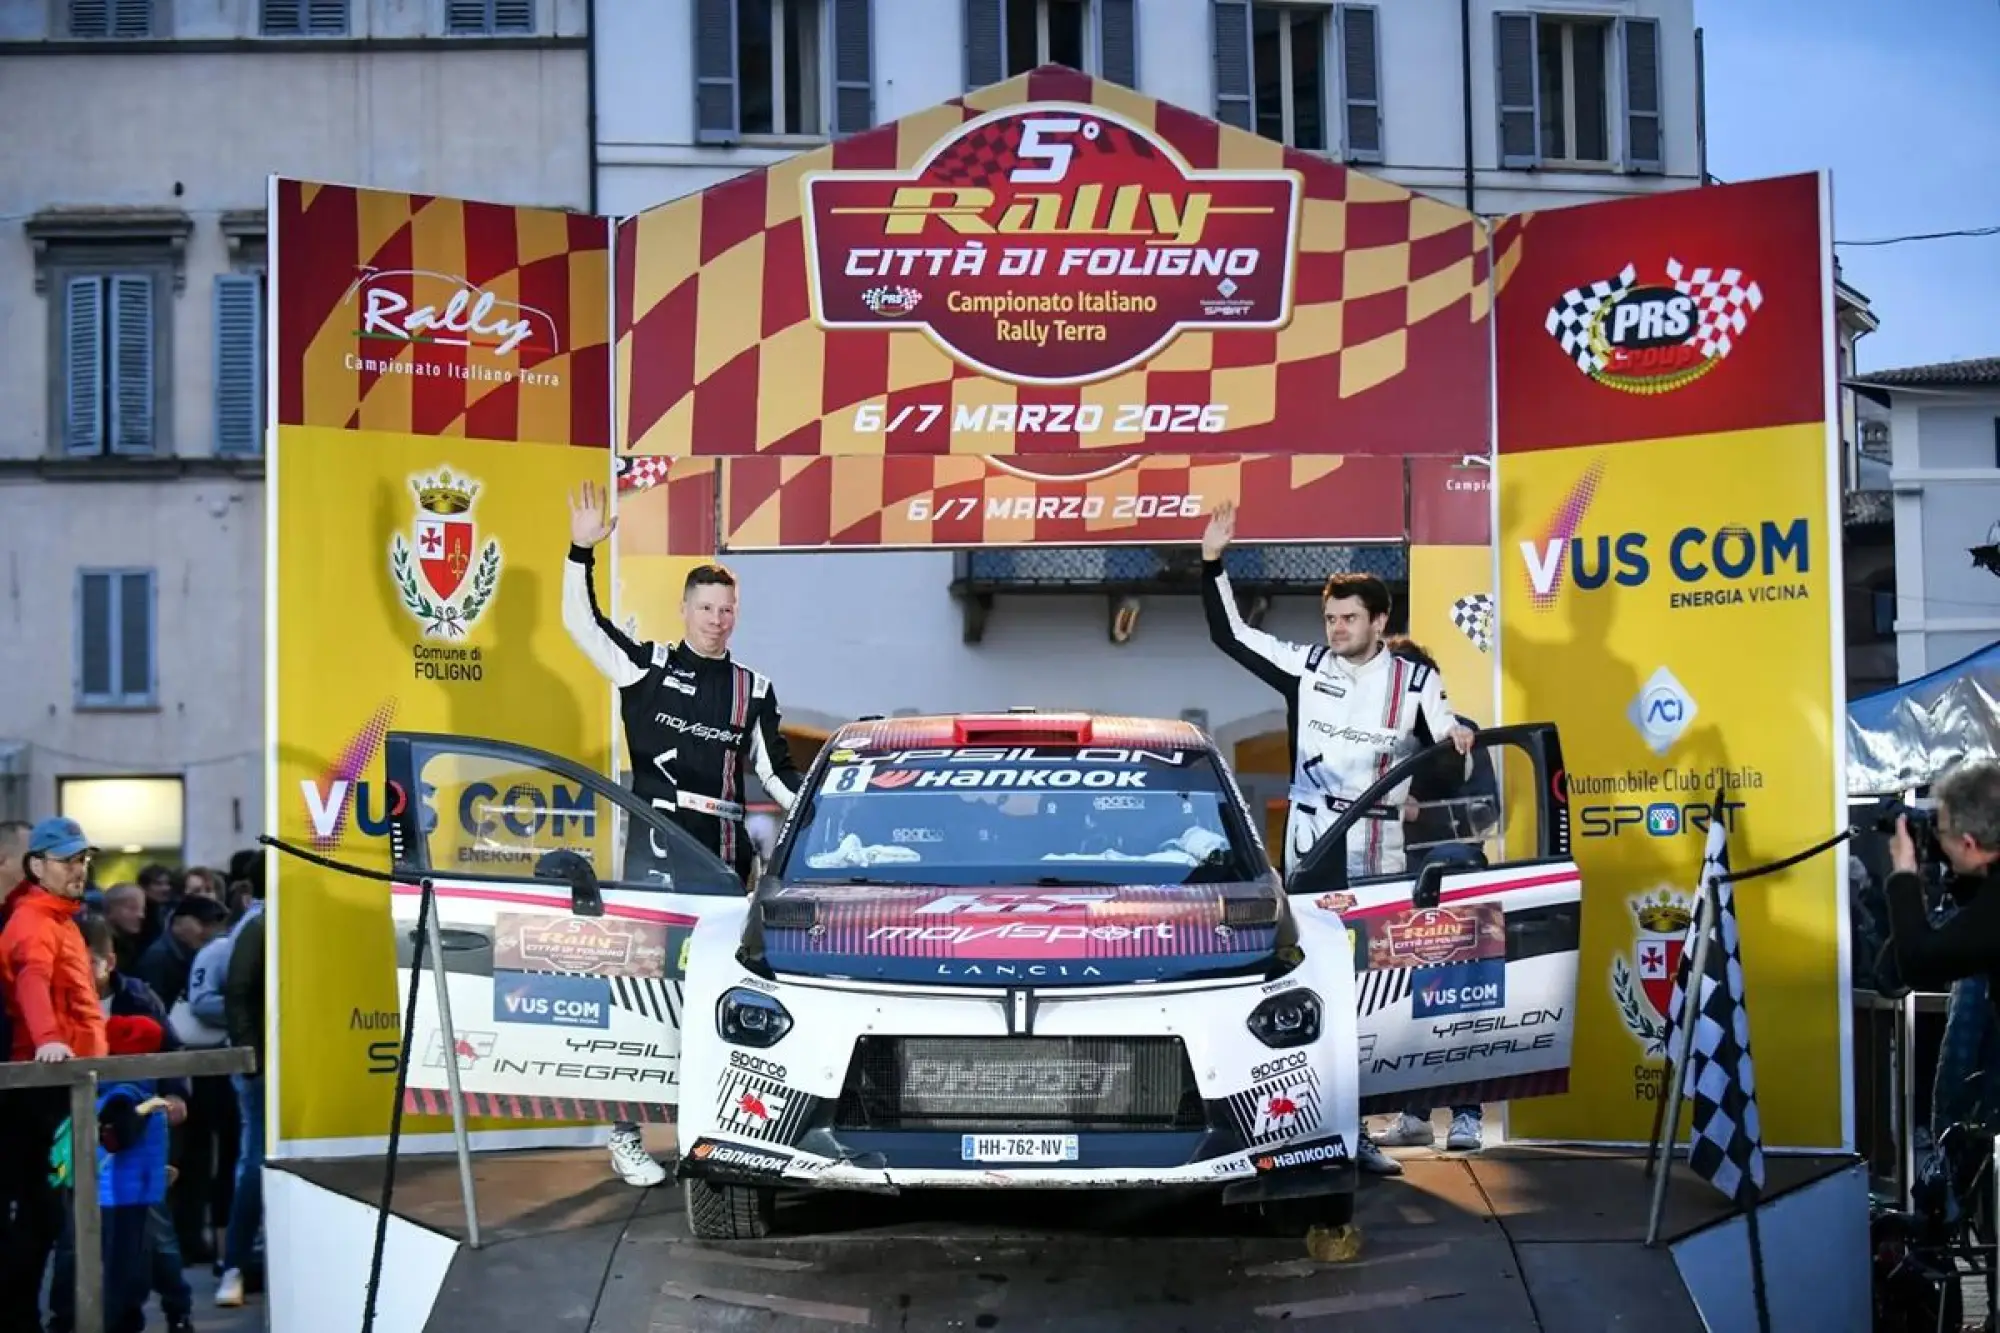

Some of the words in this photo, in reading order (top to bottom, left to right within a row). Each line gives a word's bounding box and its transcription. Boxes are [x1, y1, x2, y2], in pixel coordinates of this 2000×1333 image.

[885, 183, 1212, 245] Rally
[845, 240, 986, 277] CITTÀ
[999, 248, 1045, 277] DI
[1059, 247, 1260, 277] FOLIGNO
[947, 290, 1075, 316] Campionato
[1078, 290, 1157, 313] Italiano
[364, 288, 535, 356] Rally
[996, 319, 1050, 347] Rally
[1054, 319, 1107, 341] Terra
[1612, 296, 1692, 343] PRS
[345, 352, 442, 377] Campionato
[447, 358, 513, 383] Italiano
[519, 368, 560, 387] Terra
[853, 403, 943, 433] 6/7
[953, 404, 1103, 433] MARZO
[1113, 404, 1229, 434] 2026
[907, 497, 978, 522] 6/7
[985, 495, 1105, 520] MARZO
[1112, 494, 1205, 518] 2026
[1519, 531, 1650, 595] VUS
[1669, 518, 1810, 582] COM
[1670, 589, 1744, 610] ENERGIA
[1748, 583, 1810, 603] VICINA
[413, 644, 467, 661] Comune
[470, 647, 482, 661] di
[414, 662, 483, 682] FOLIGNO
[1648, 698, 1684, 722] ACI
[849, 747, 1184, 766] YPSILON
[836, 767, 860, 792] 8
[1663, 767, 1701, 792] Club
[1705, 766, 1764, 790] d'Italia
[459, 782, 596, 838] COM
[1580, 802, 1747, 837] SPORT
[867, 921, 1174, 944] movisport
[938, 964, 1102, 976] LANCIA
[504, 994, 549, 1013] VUS
[553, 1000, 599, 1019] COM
[1422, 988, 1458, 1007] VUS
[1460, 984, 1498, 1002] COM
[1432, 1007, 1564, 1038] YPSILON
[567, 1038, 680, 1060] YPSIL
[1371, 1032, 1556, 1074] INTEGRALE
[493, 1058, 680, 1086] INTEGRAL
[730, 1049, 788, 1080] sparco
[1251, 1050, 1307, 1080] sparco
[978, 1138, 1063, 1156] HH-762-NV
